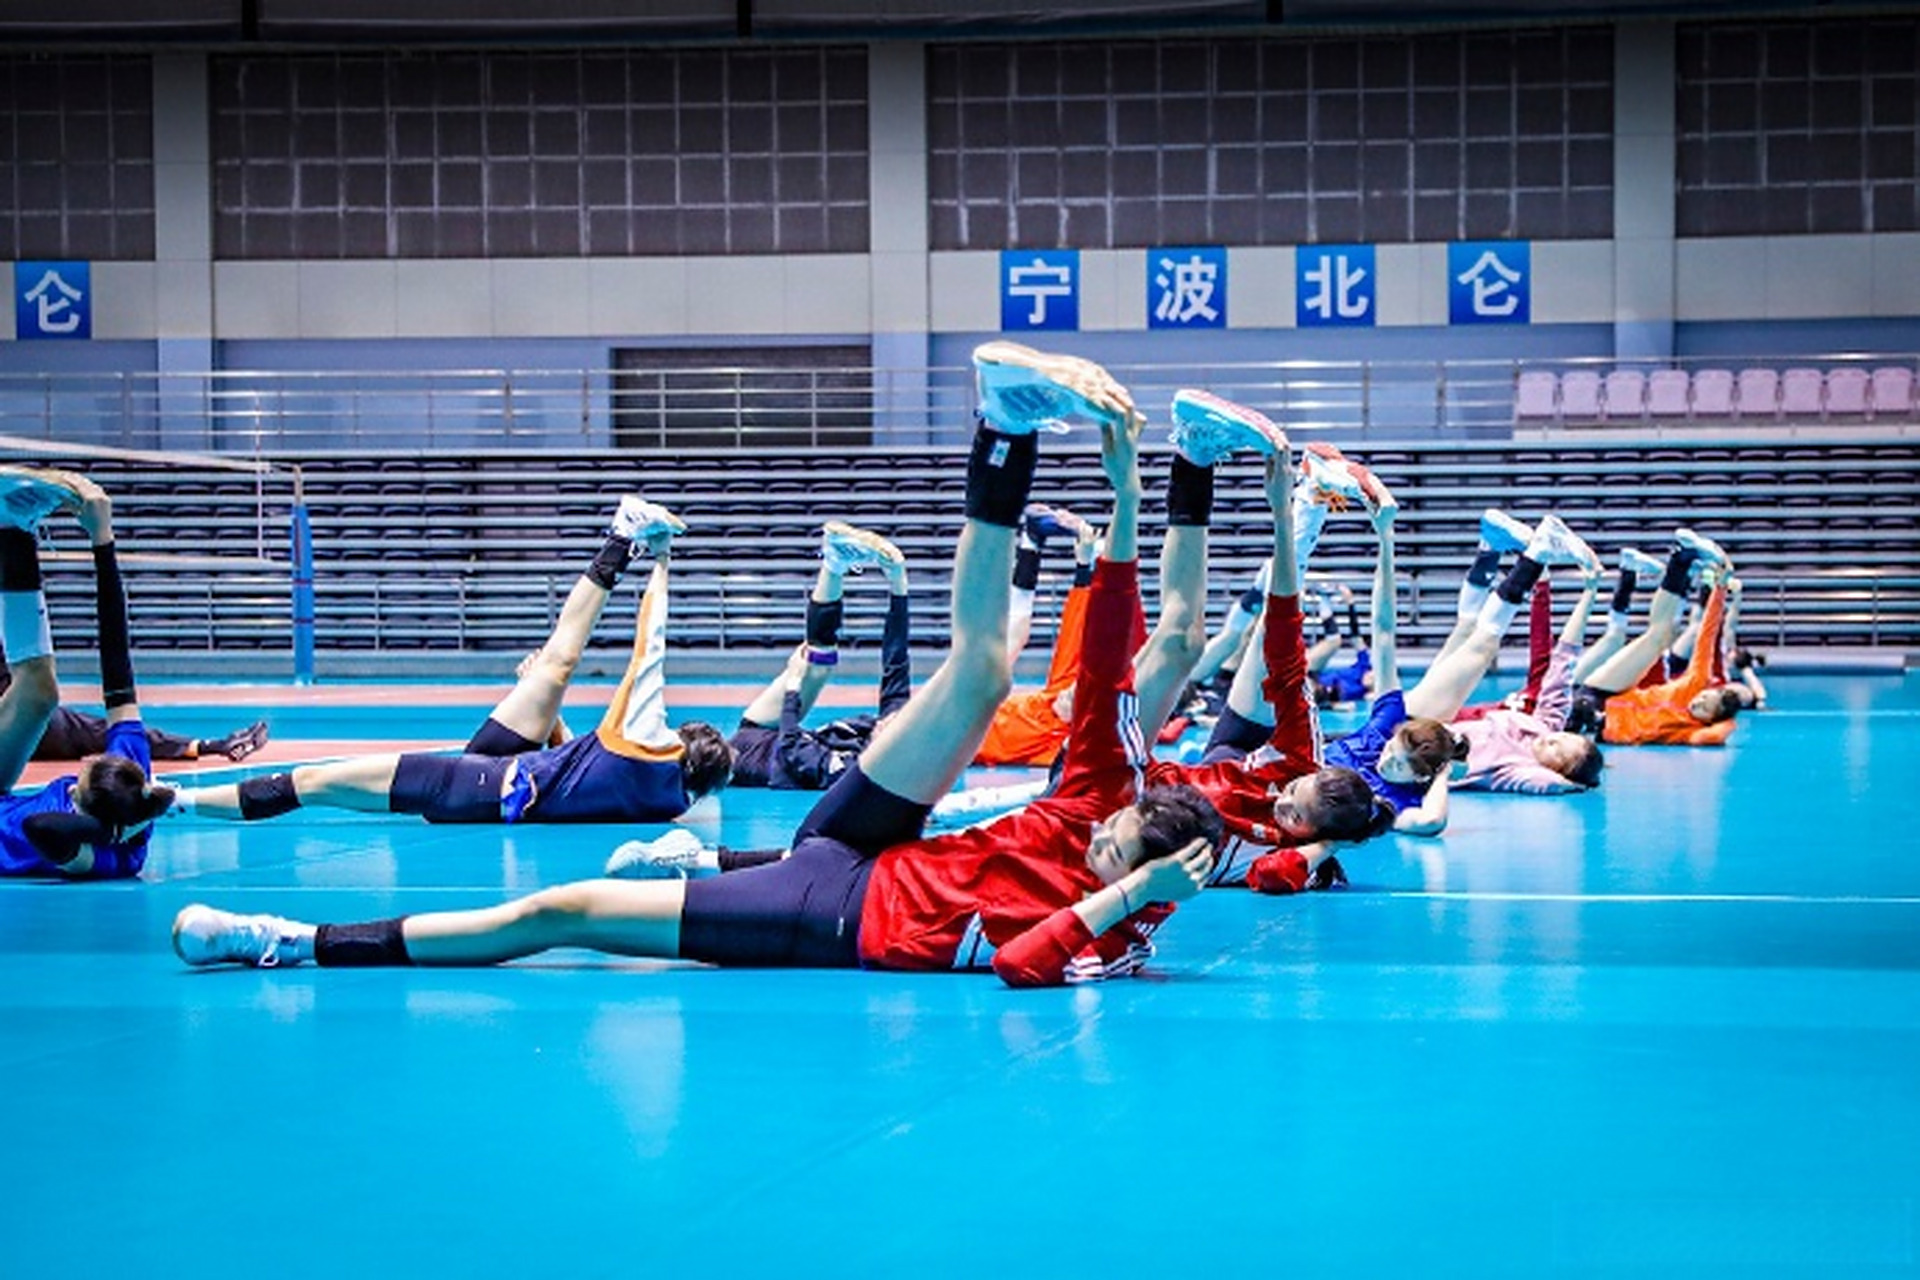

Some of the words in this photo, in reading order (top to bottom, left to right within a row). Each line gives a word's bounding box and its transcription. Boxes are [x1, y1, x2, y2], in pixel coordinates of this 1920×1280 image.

[23, 269, 82, 333] 仑
[1008, 250, 1522, 325] 宁波北仑
